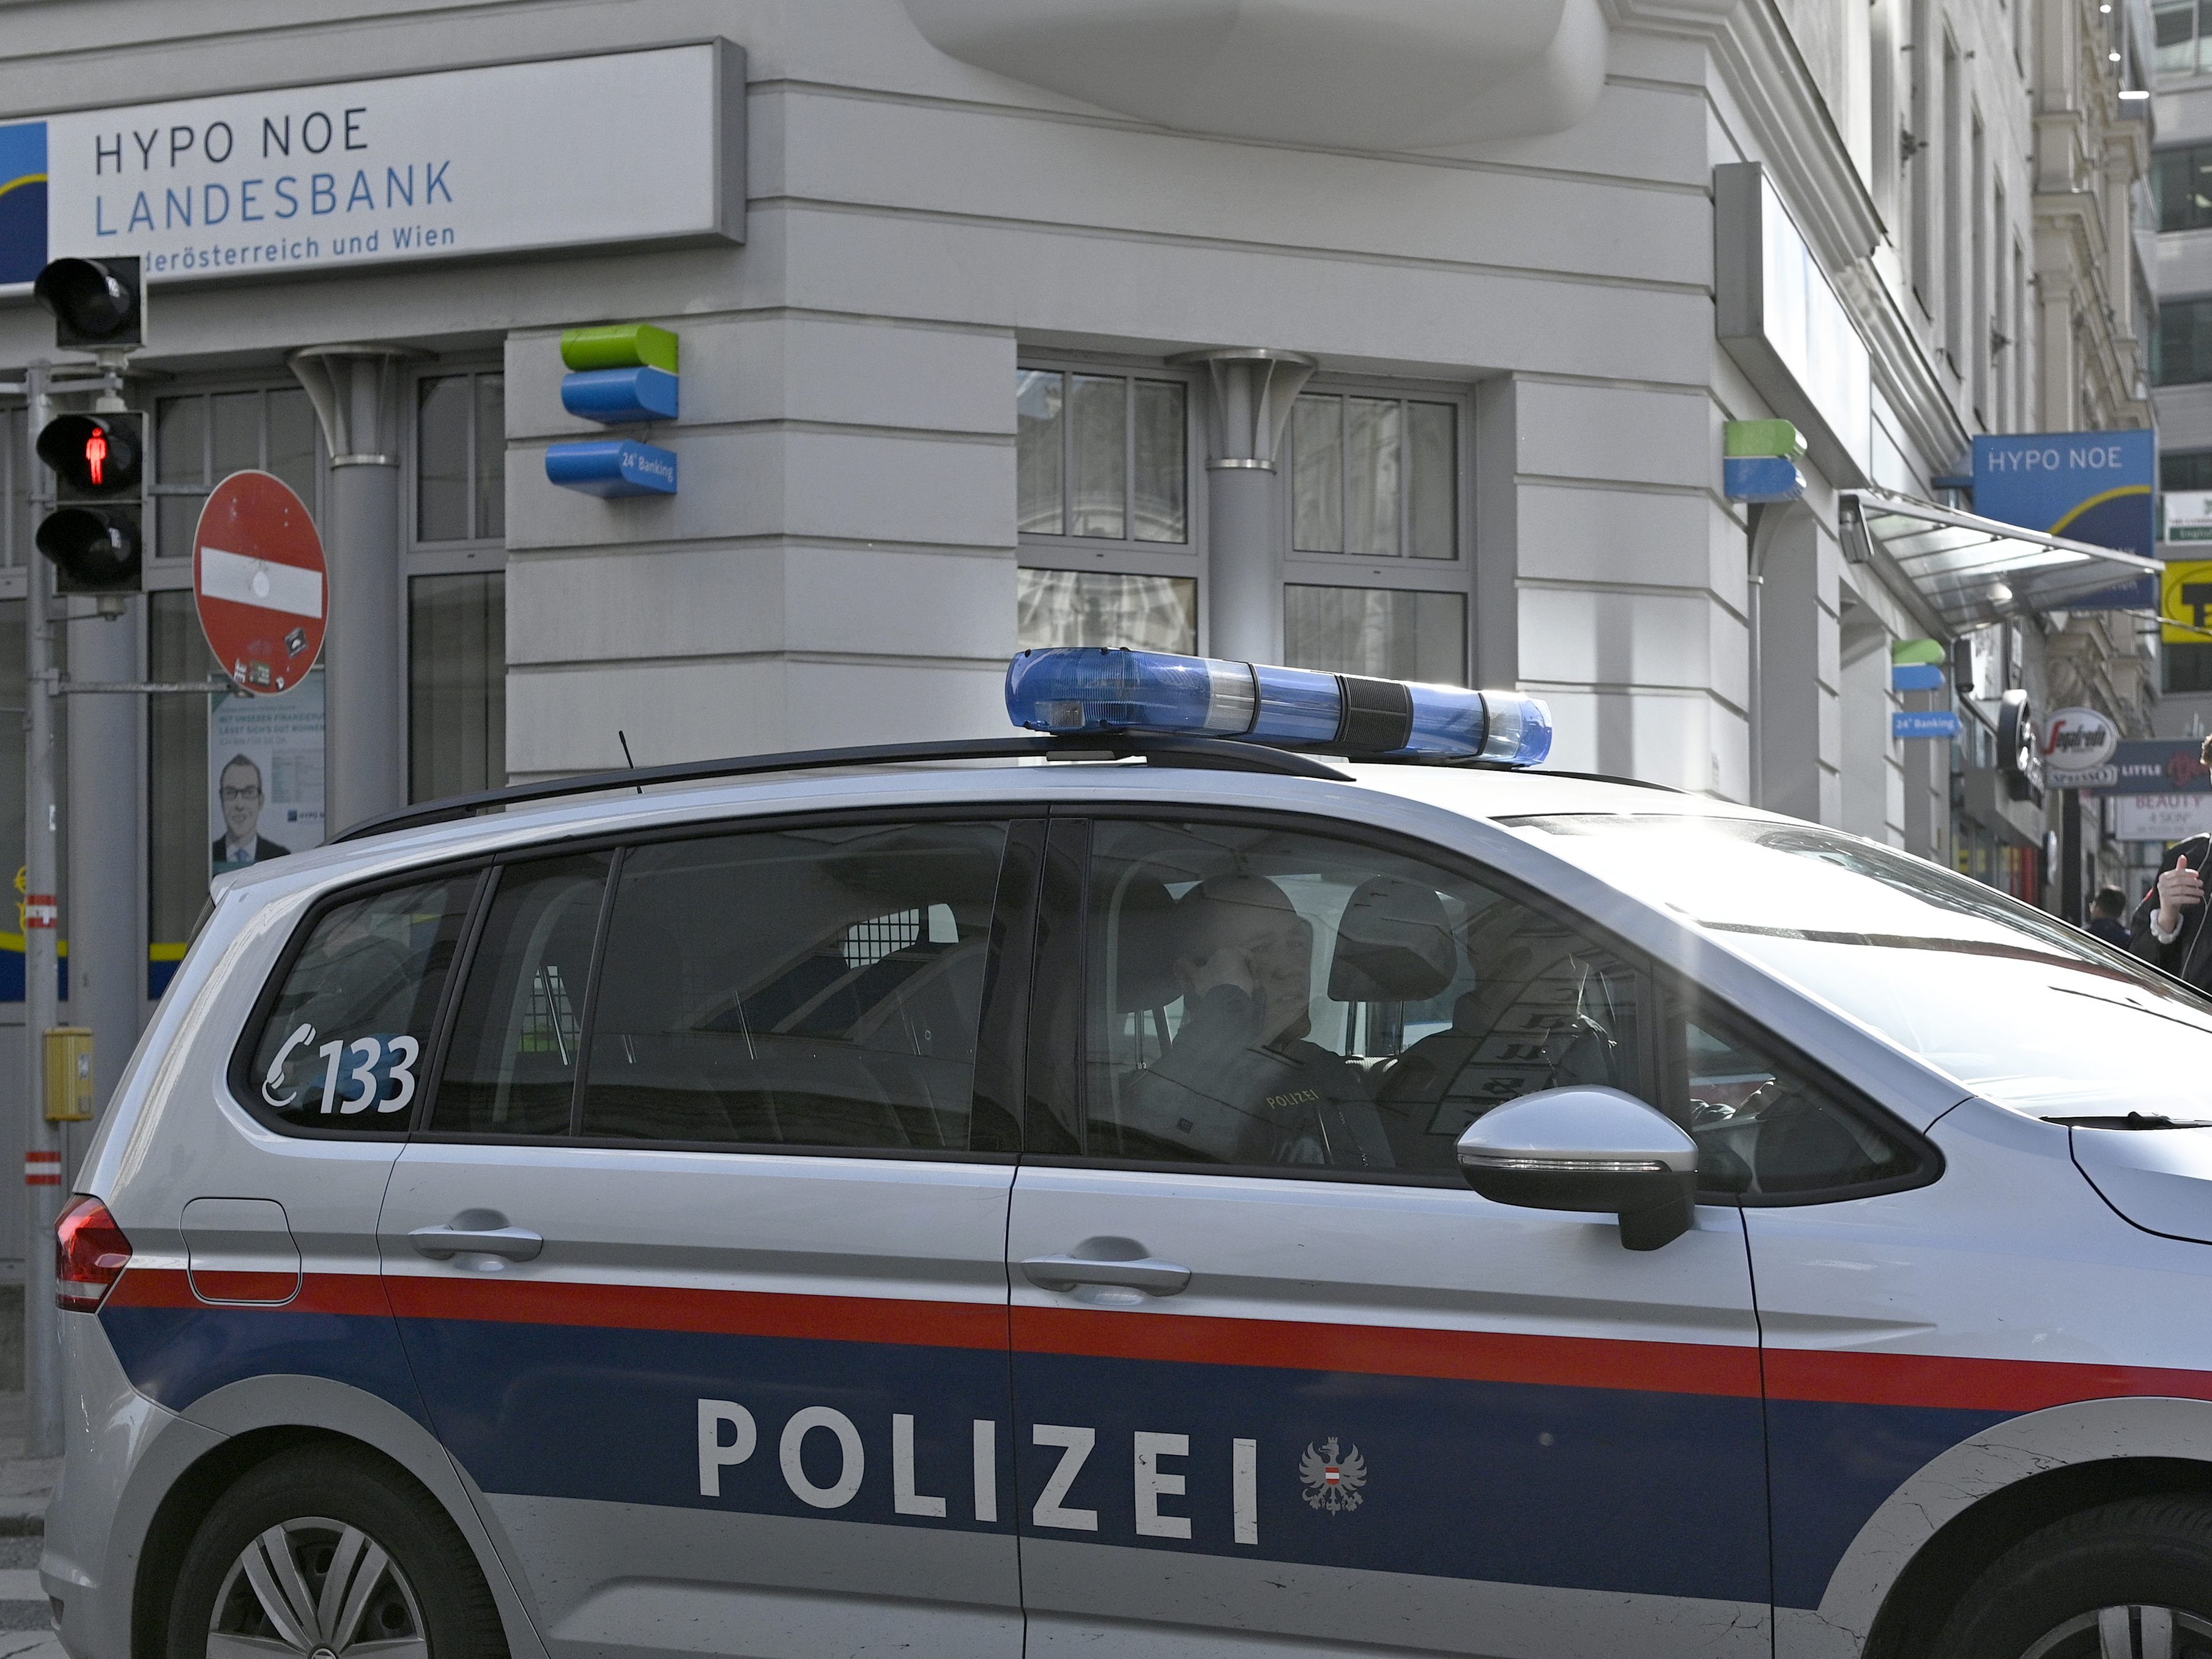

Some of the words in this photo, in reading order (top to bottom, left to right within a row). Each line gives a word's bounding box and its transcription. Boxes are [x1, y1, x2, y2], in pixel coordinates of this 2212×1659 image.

[96, 122, 232, 175] HYPO
[263, 108, 368, 158] NOE
[95, 160, 453, 237] LANDESBANK
[144, 236, 319, 273] derösterreich
[333, 230, 379, 256] und
[393, 226, 455, 250] Wien
[638, 455, 674, 483] Banking
[1988, 448, 2060, 473] HYPO
[2069, 446, 2123, 469] NOE
[1913, 718, 1954, 730] Banking
[2121, 763, 2162, 776] LITTLE
[319, 1036, 419, 1114] 133
[1266, 1089, 1320, 1110] POLIZEI
[698, 1398, 1258, 1545] POLIZEI
